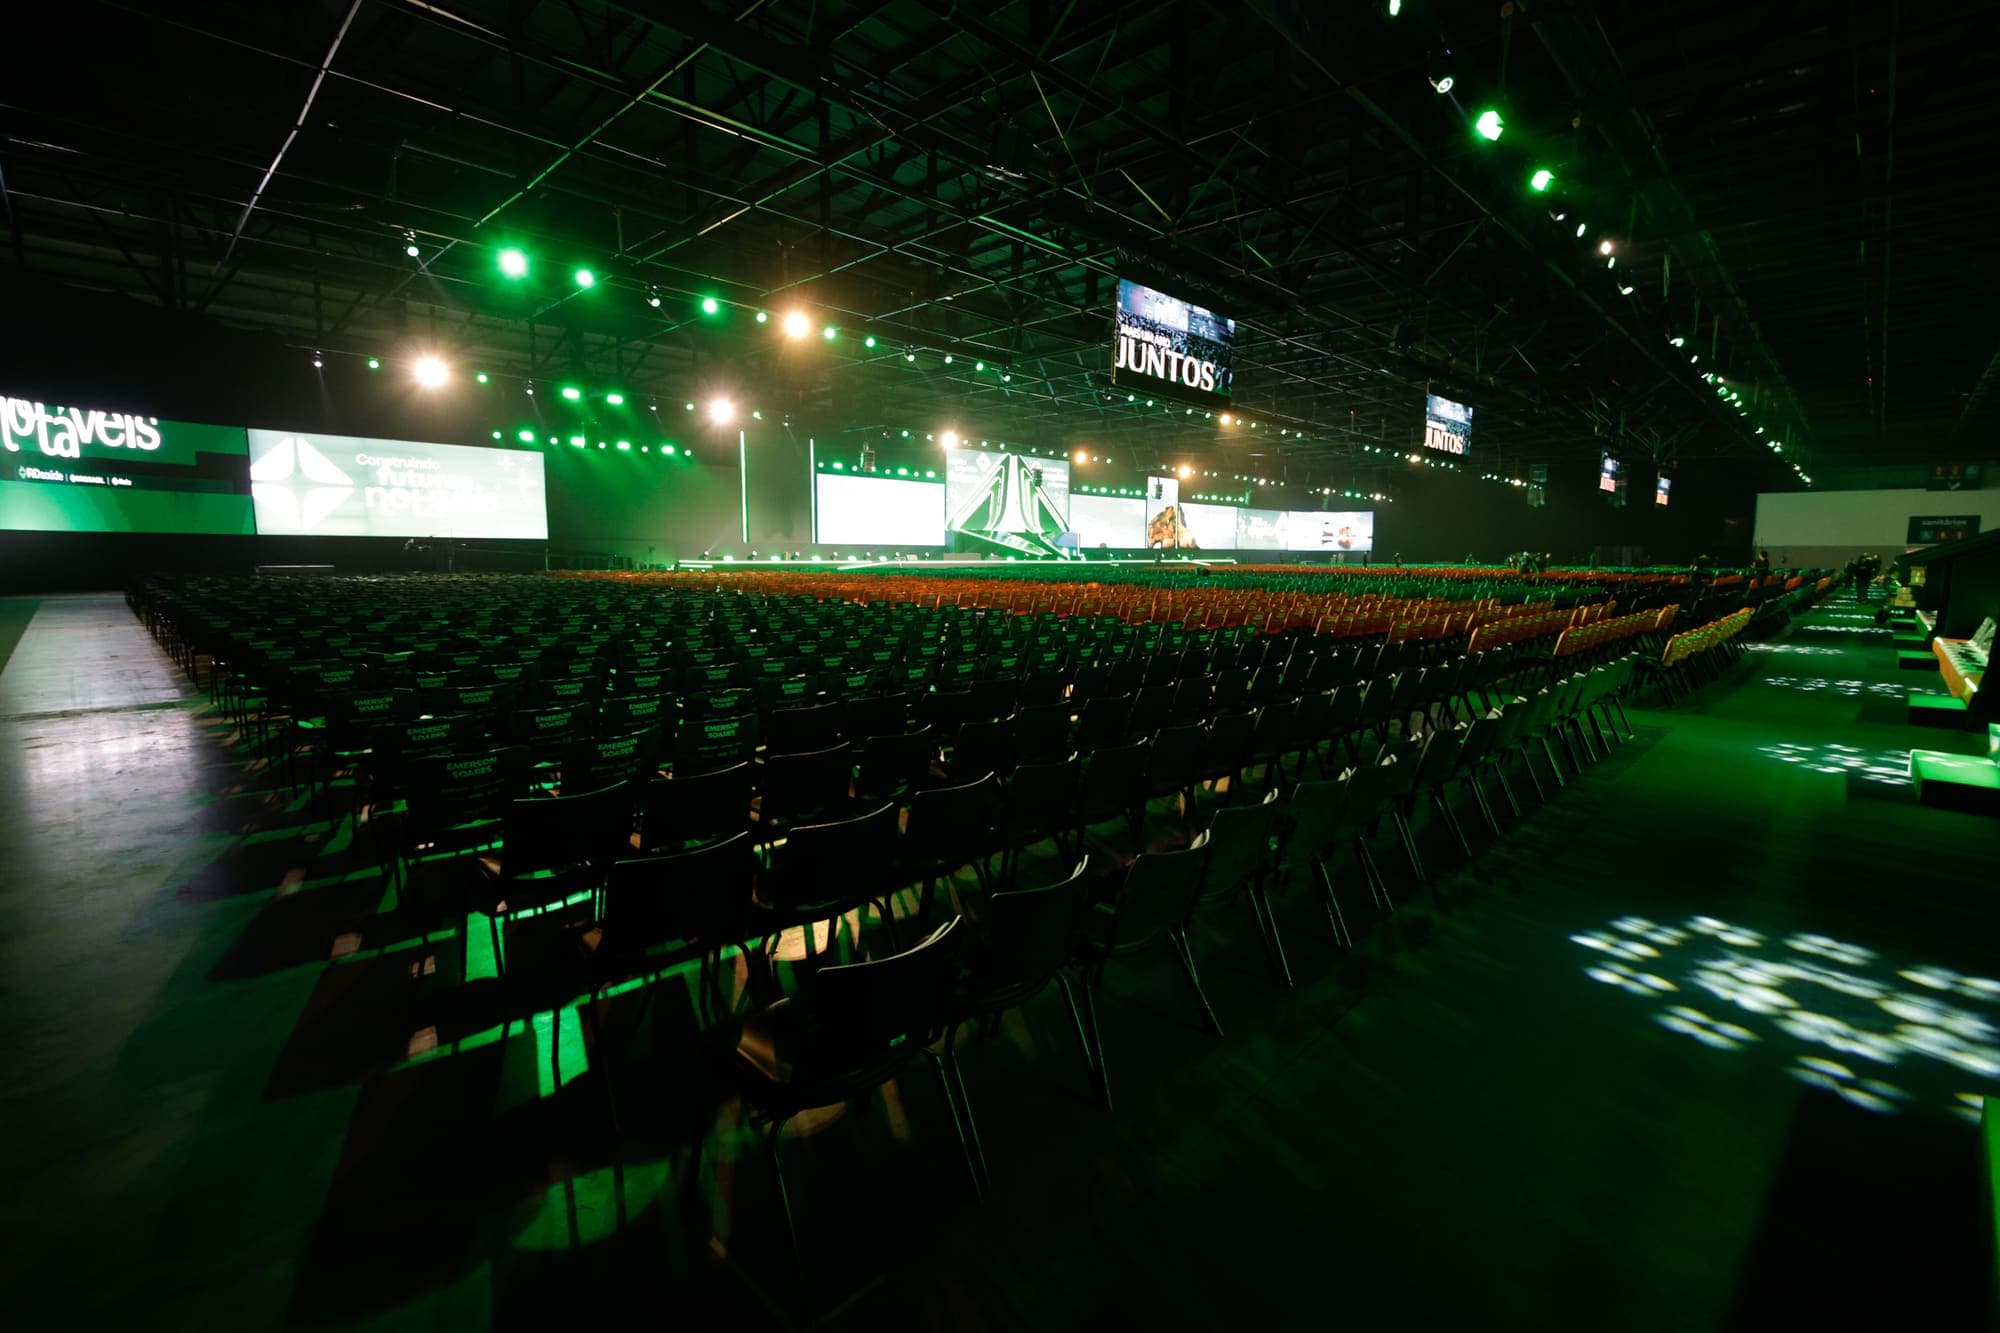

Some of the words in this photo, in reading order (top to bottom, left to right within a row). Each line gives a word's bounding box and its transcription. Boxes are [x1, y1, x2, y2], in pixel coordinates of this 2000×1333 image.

[1115, 335, 1215, 391] JUNTOS
[1424, 426, 1463, 454] JUNTOS
[356, 453, 440, 470] Construindo
[597, 737, 638, 751] EMERSON
[447, 756, 497, 771] EMERSON
[450, 766, 493, 779] SOARES
